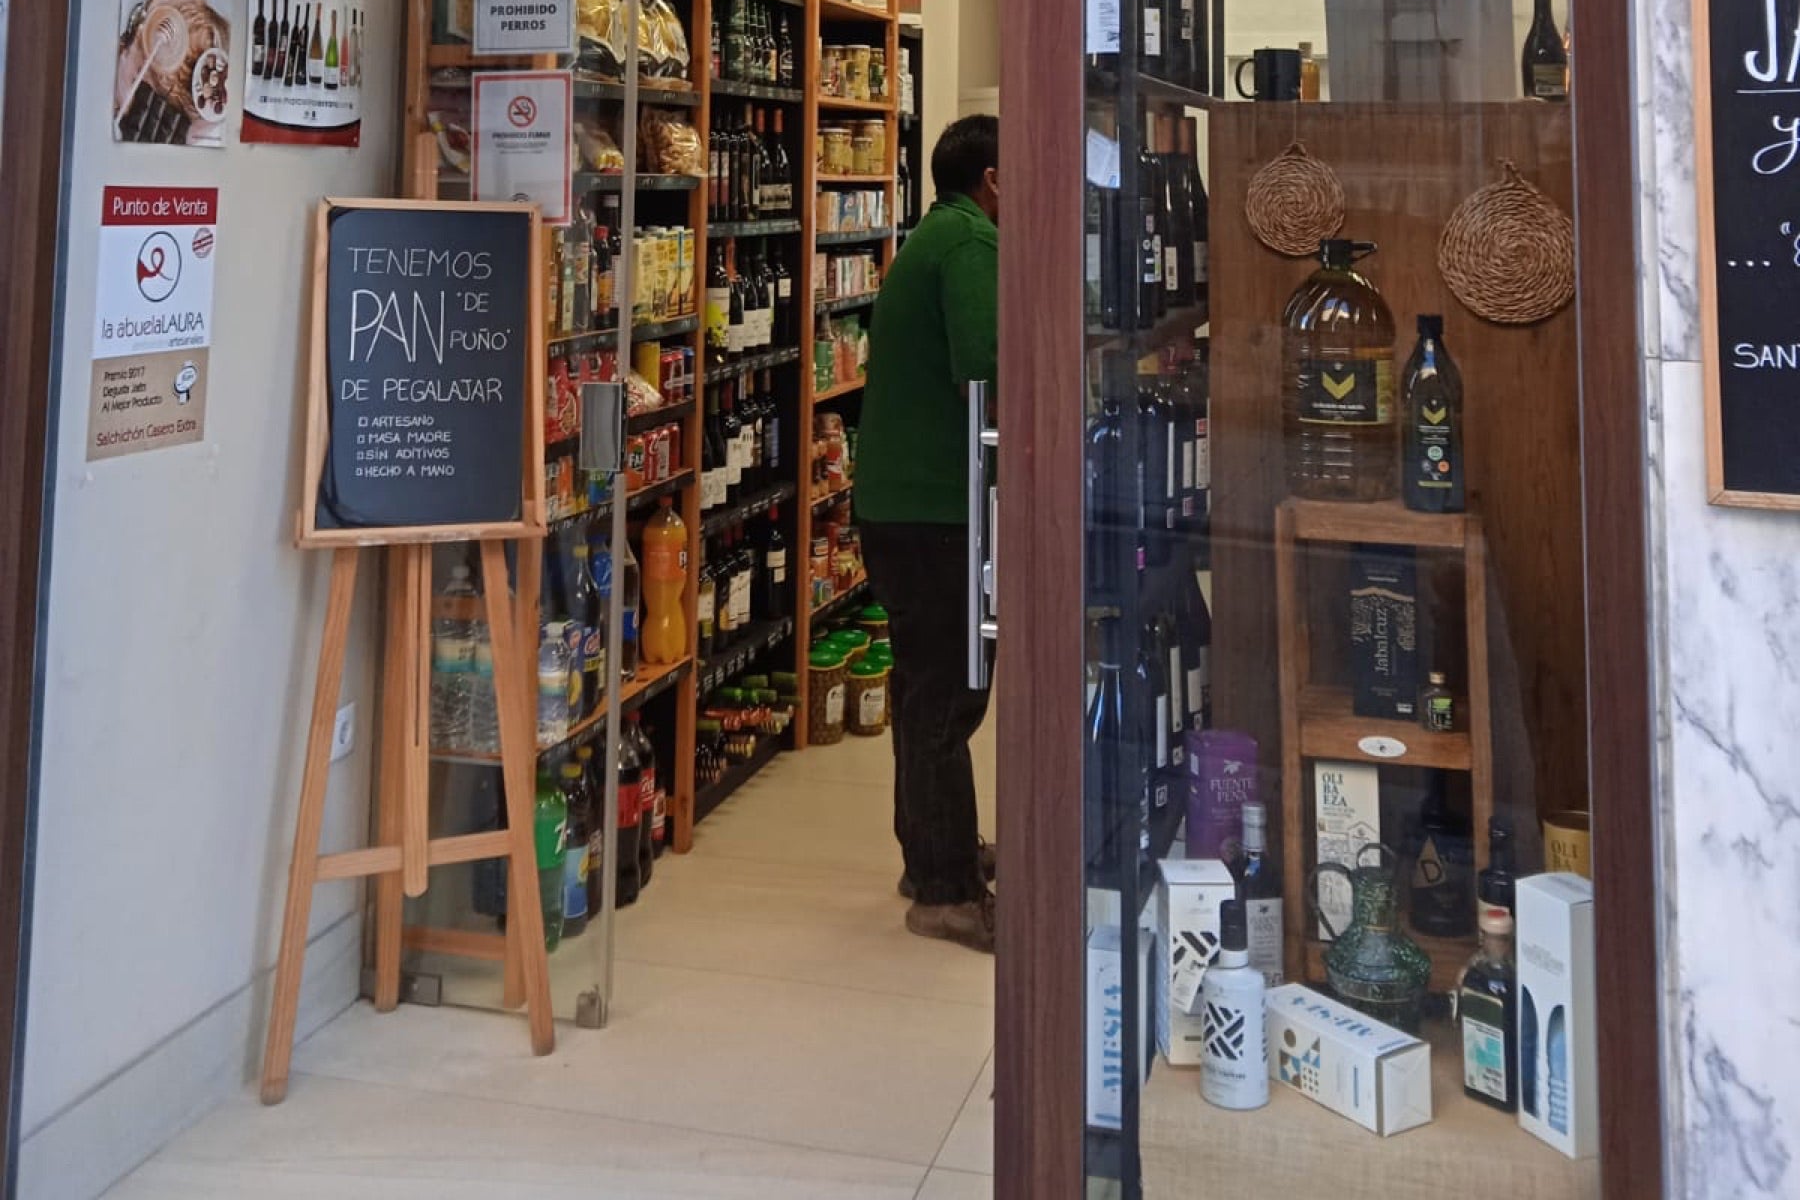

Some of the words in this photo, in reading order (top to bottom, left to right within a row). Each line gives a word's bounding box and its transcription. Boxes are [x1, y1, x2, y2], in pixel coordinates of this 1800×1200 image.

[490, 4, 556, 16] PROHIBIDO
[501, 20, 546, 31] PERROS
[113, 196, 149, 217] Punto
[152, 200, 170, 216] de
[173, 197, 208, 216] Venta
[348, 248, 492, 280] TENEMOS
[101, 318, 113, 339] la
[350, 288, 445, 365] PAN
[342, 379, 369, 400] DE
[383, 378, 503, 403] PEGALAJAR
[111, 400, 130, 411] Mejor
[132, 395, 163, 408] Producto
[371, 415, 434, 428] ARTESANO
[96, 426, 145, 447] Salchichón
[147, 423, 175, 437] Casero
[176, 419, 197, 433] Extra
[368, 432, 401, 445] MASA
[407, 431, 451, 443] MADRE
[366, 448, 388, 461] SIN
[395, 447, 450, 460] ADITIVOS
[365, 465, 401, 478] HECHO
[406, 464, 415, 477] A
[421, 464, 455, 477] MANO
